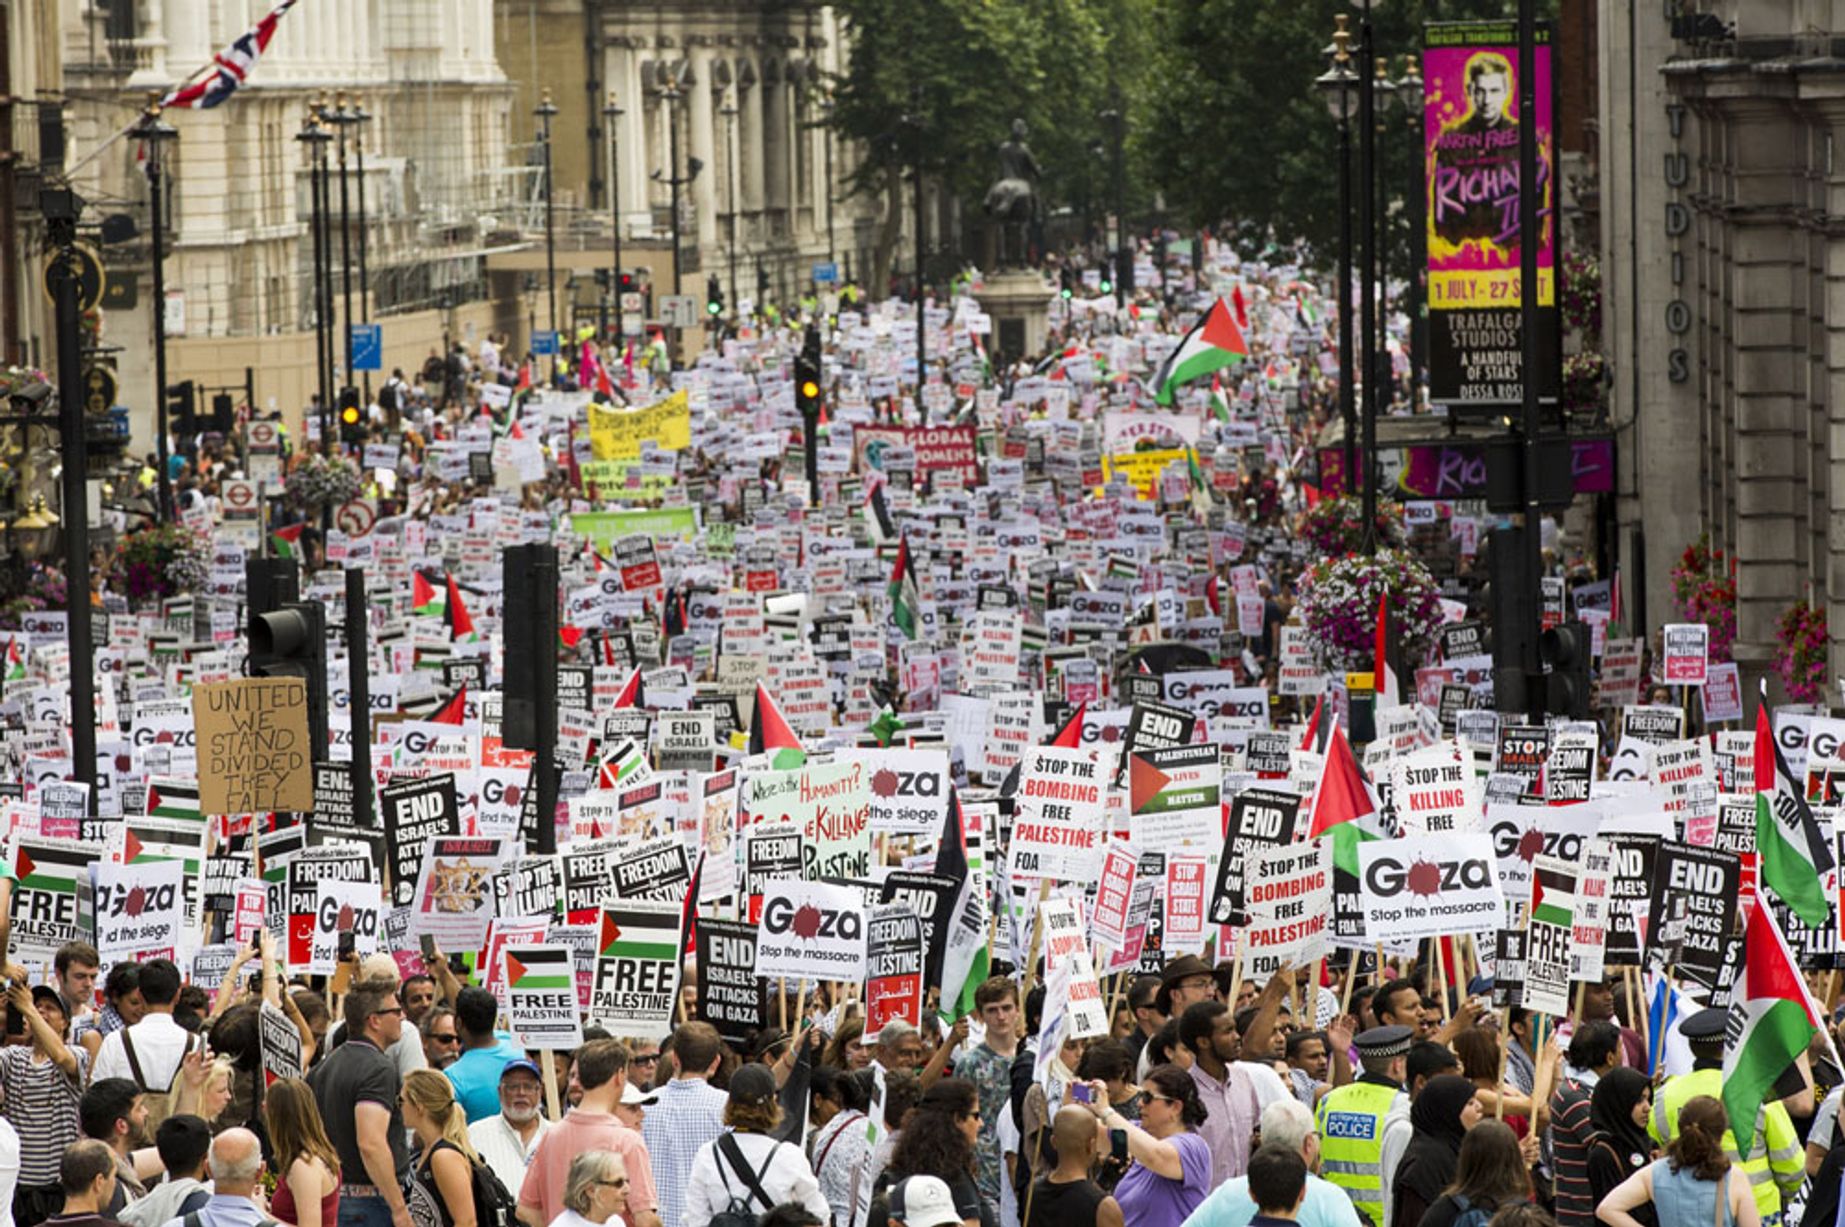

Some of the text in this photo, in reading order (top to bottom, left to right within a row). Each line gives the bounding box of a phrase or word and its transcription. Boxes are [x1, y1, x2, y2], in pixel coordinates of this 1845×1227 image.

[1664, 104, 1691, 385] TUDIOS
[1435, 277, 1546, 300] 1 JULY 27 ST
[1448, 313, 1522, 330] TRAFALGA
[1452, 331, 1516, 348] STUDIOS
[1460, 352, 1468, 366] A
[1467, 365, 1518, 381] OF STARS
[1460, 385, 1494, 399] DESSA
[914, 448, 975, 463] OMEN'S
[1073, 596, 1121, 614] Gza
[982, 629, 1013, 641] KILLING
[1447, 627, 1478, 644] END
[730, 660, 757, 672] STOP
[975, 652, 1016, 664] PALESTINE
[208, 684, 304, 713] UNITED
[1201, 701, 1263, 720] Gza
[231, 710, 276, 732] WE
[672, 721, 701, 736] END
[994, 715, 1029, 728] STOP THE
[1140, 712, 1182, 739] END
[1629, 716, 1677, 733] FREEDOM
[210, 729, 295, 755] STAND
[664, 738, 708, 748] ISRAELI
[994, 728, 1029, 741] KILLING
[1001, 742, 1019, 751] FREE
[1154, 746, 1216, 762] PALESTINIAN
[1504, 740, 1546, 754] STOP
[210, 752, 304, 774] DIVIDED
[986, 754, 1019, 768] PALEST
[1035, 754, 1094, 778] STOP THE
[1657, 753, 1682, 768] STOP
[223, 770, 291, 793] THEY
[1173, 771, 1200, 781] LIVES
[1406, 765, 1463, 785] STOP THE
[1658, 765, 1703, 784] KILLING
[1026, 779, 1098, 803] BOMBING
[1409, 788, 1464, 812] KILLING
[225, 790, 291, 813] FALL
[396, 791, 444, 826] END
[896, 807, 938, 824] siege
[1042, 804, 1071, 820] FREE
[1239, 804, 1284, 838] END
[395, 818, 450, 843] ISRAEL'S
[1426, 814, 1454, 832] FREE
[1016, 823, 1095, 848] PALESTINE
[1716, 833, 1756, 853] PALEST
[752, 838, 799, 861] FREEDOM
[296, 860, 365, 882] FREEDOM
[399, 860, 417, 876] ON
[618, 849, 683, 886] FREEDOM
[1015, 852, 1039, 871] FOA
[1259, 851, 1319, 878] STOP THE
[1613, 849, 1644, 878] ND
[1175, 865, 1198, 879] STOP
[1365, 857, 1492, 898] Gza
[1670, 858, 1725, 895] END
[1225, 875, 1243, 892] ON
[1252, 871, 1325, 904] BOMBING
[1173, 898, 1198, 914] STATE
[1274, 900, 1304, 920] FREE
[1370, 900, 1496, 922] Stop the massacre
[764, 896, 862, 941] Gza
[1338, 920, 1356, 935] FOA
[120, 923, 171, 943] the siege
[870, 917, 917, 945] FREEDOM
[1250, 912, 1326, 948] PALESTINE
[314, 945, 330, 960] End
[709, 935, 754, 968] END
[1528, 920, 1571, 966] FREE
[760, 945, 860, 964] Stop the massacre
[1253, 955, 1280, 973] FOA
[596, 958, 676, 994] FREE
[706, 967, 758, 987] ISRAEL'S
[1526, 959, 1569, 985] PALESTINE
[511, 993, 572, 1009] FREE
[593, 991, 671, 1011] PALESTINE
[706, 985, 758, 1006] ATTACKS
[513, 1010, 573, 1020] PALESTINE
[706, 1004, 759, 1025] ON GAZA
[1328, 1122, 1372, 1137] POLICE
